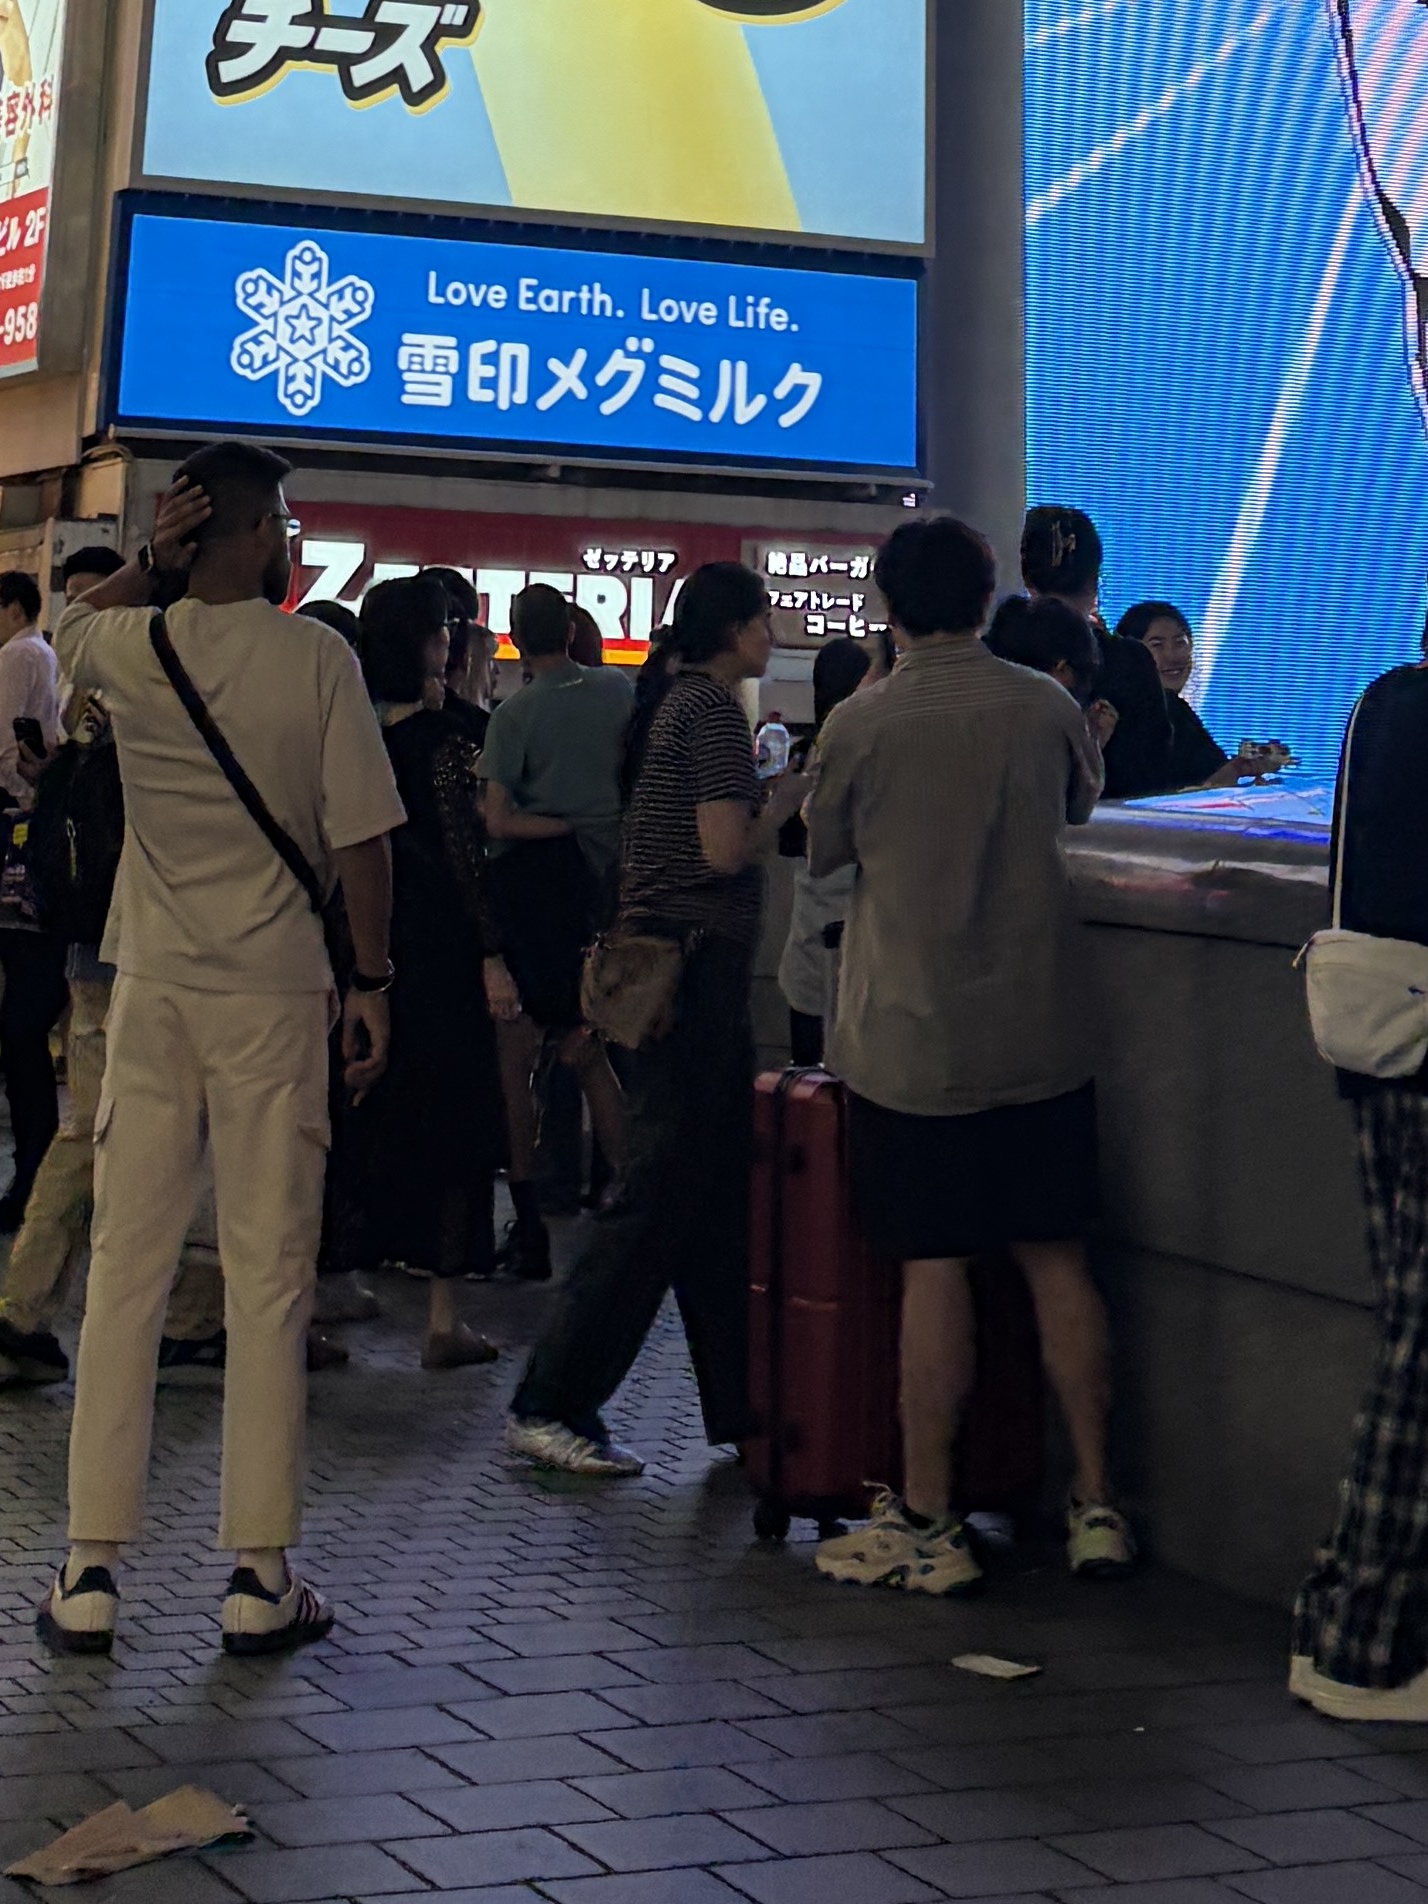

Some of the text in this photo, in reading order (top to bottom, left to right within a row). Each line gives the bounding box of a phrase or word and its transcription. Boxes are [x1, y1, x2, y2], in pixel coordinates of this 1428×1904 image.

[23, 206, 47, 248] 2F
[427, 268, 800, 335] Love Earth. Love Life.
[397, 332, 824, 429] 雪印メグミルク
[582, 548, 675, 574] ゼッテリア
[768, 550, 875, 579] 絶品バーガ
[768, 590, 865, 612] フェアトレード
[806, 614, 888, 637] コーヒー
